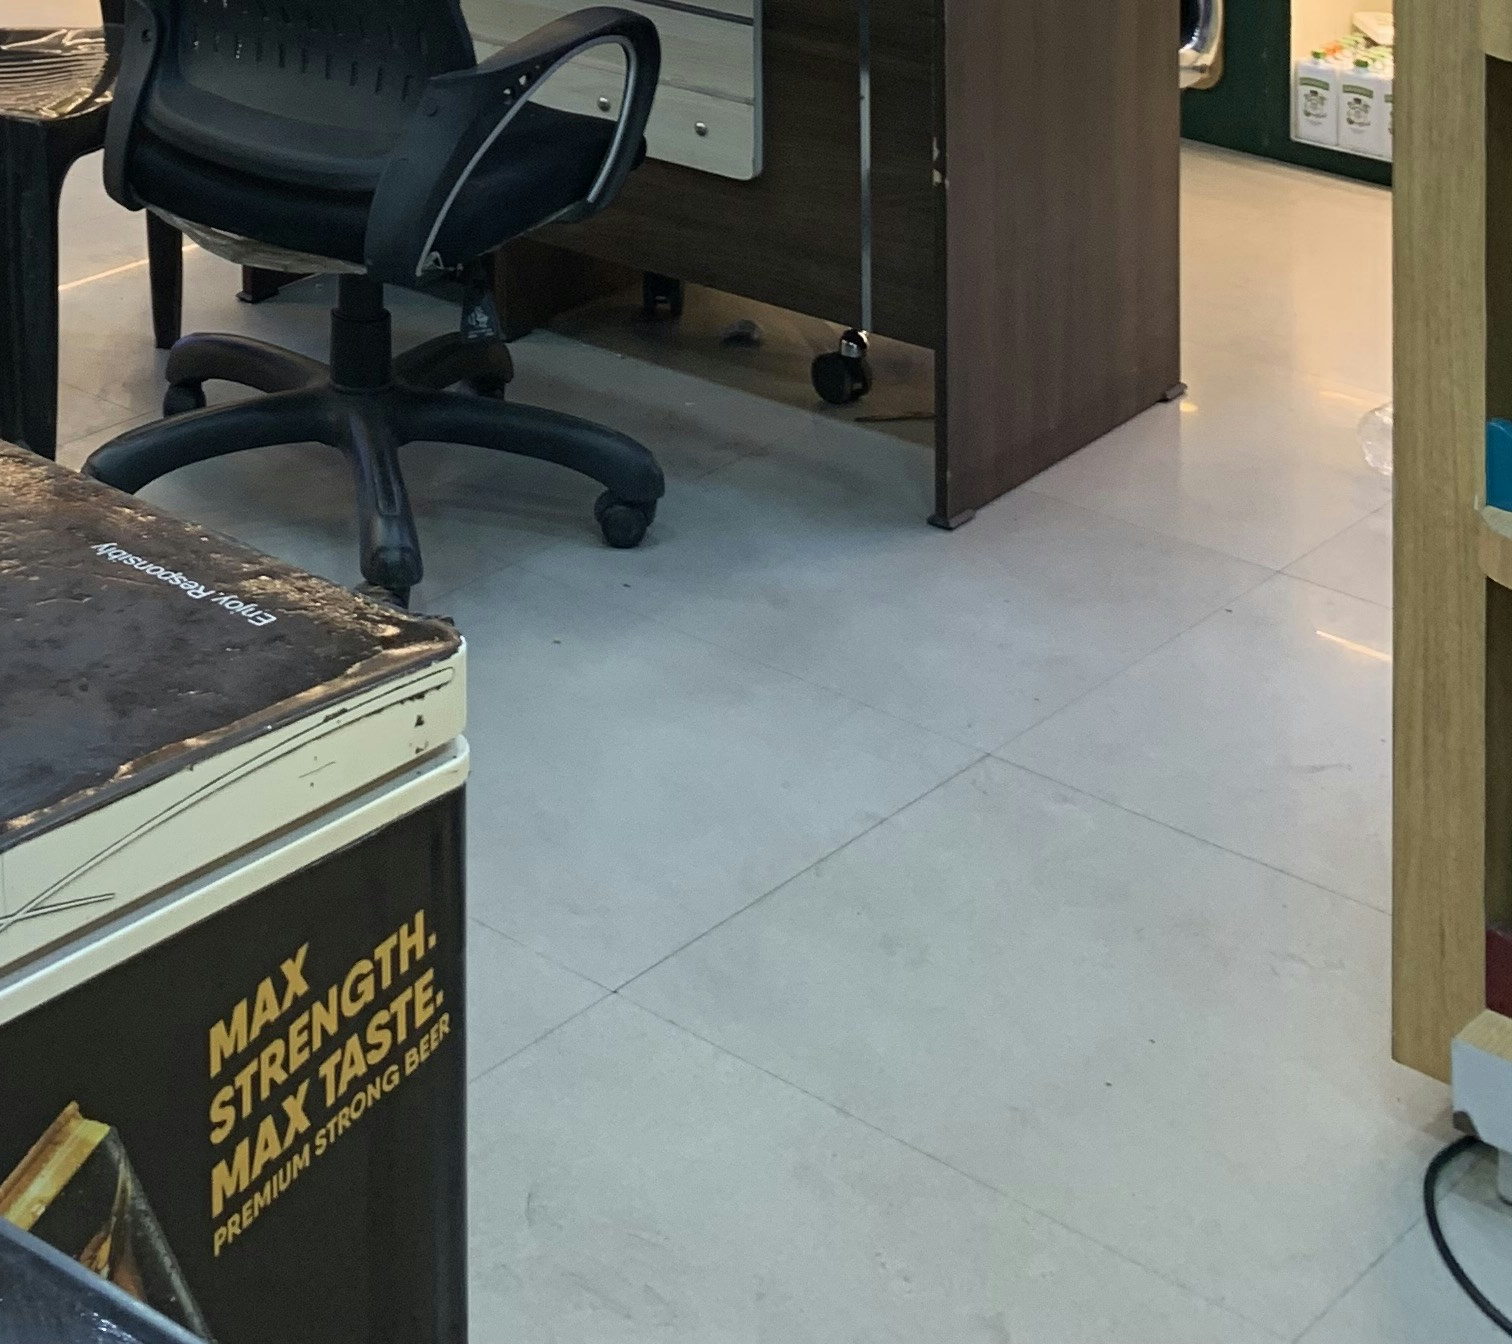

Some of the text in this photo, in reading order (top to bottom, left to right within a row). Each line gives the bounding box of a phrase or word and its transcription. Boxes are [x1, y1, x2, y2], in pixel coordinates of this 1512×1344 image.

[90, 542, 215, 600] Responsibly
[208, 941, 311, 1080] MAX
[209, 908, 438, 1145] STRENGTH.
[209, 967, 445, 1219] MAX TASTE.
[213, 1012, 451, 1257] PREMIUM STRONG BEER
